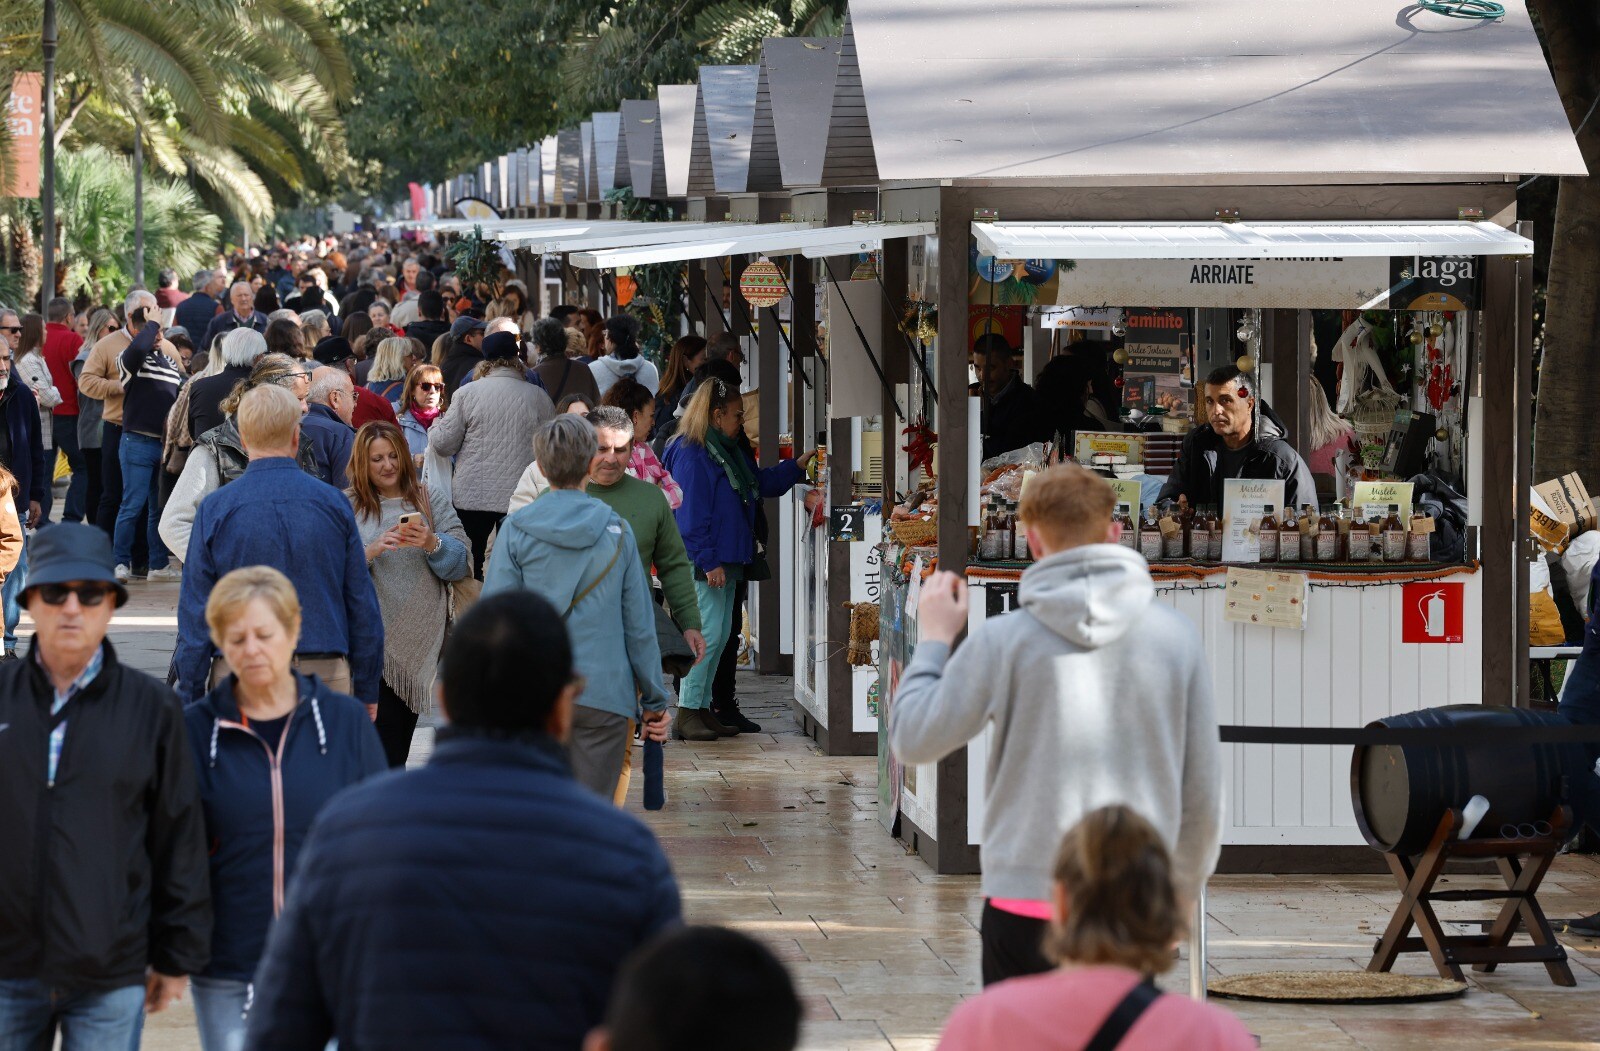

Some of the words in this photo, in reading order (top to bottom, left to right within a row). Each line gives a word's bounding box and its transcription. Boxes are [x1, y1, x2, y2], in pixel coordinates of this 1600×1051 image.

[1189, 264, 1254, 284] ARRIATE
[1412, 254, 1475, 286] laga
[840, 513, 853, 533] 2
[1000, 592, 1011, 614] 1
